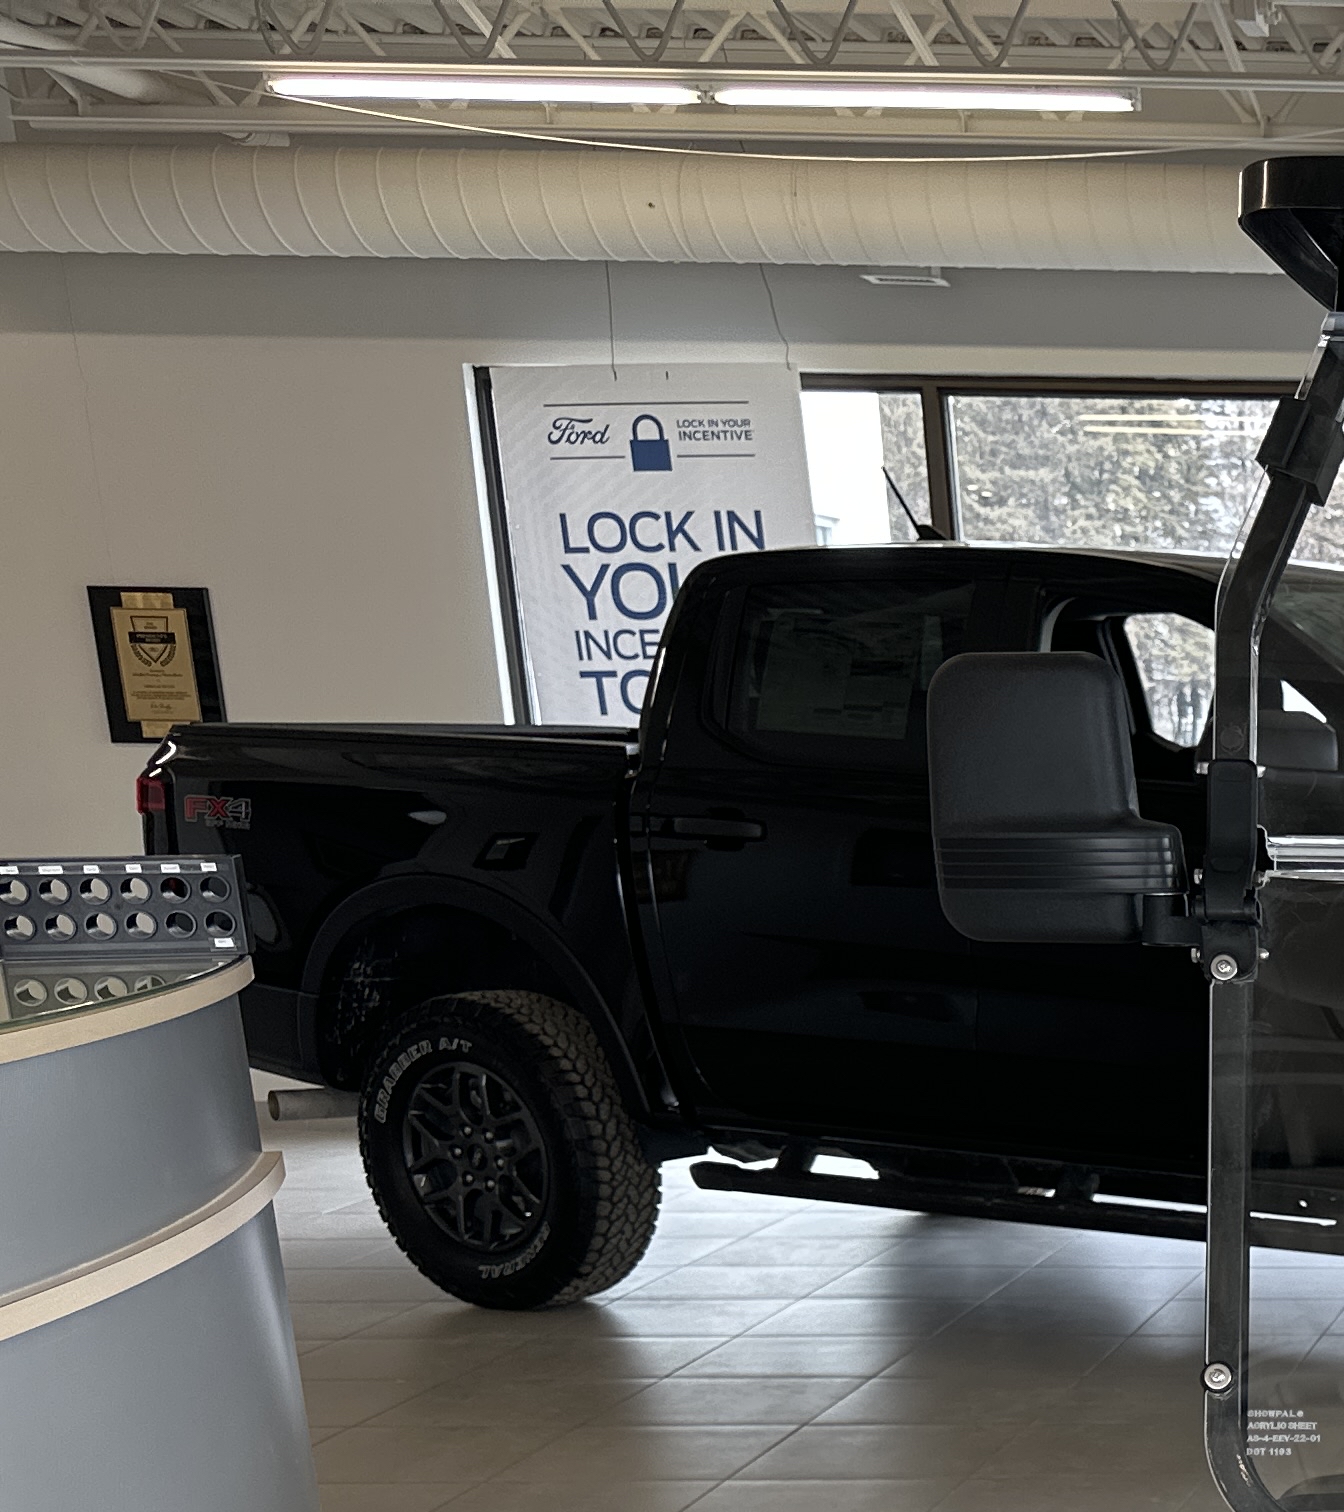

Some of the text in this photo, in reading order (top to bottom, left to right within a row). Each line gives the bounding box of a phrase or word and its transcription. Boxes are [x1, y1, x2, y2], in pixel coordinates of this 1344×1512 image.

[548, 416, 611, 446] Ford
[677, 418, 751, 429] LOCK IN YOUR
[677, 429, 753, 442] INCENTIVE
[559, 510, 766, 554] LOCK IN
[575, 629, 662, 662] INCE
[184, 793, 253, 823] FX4
